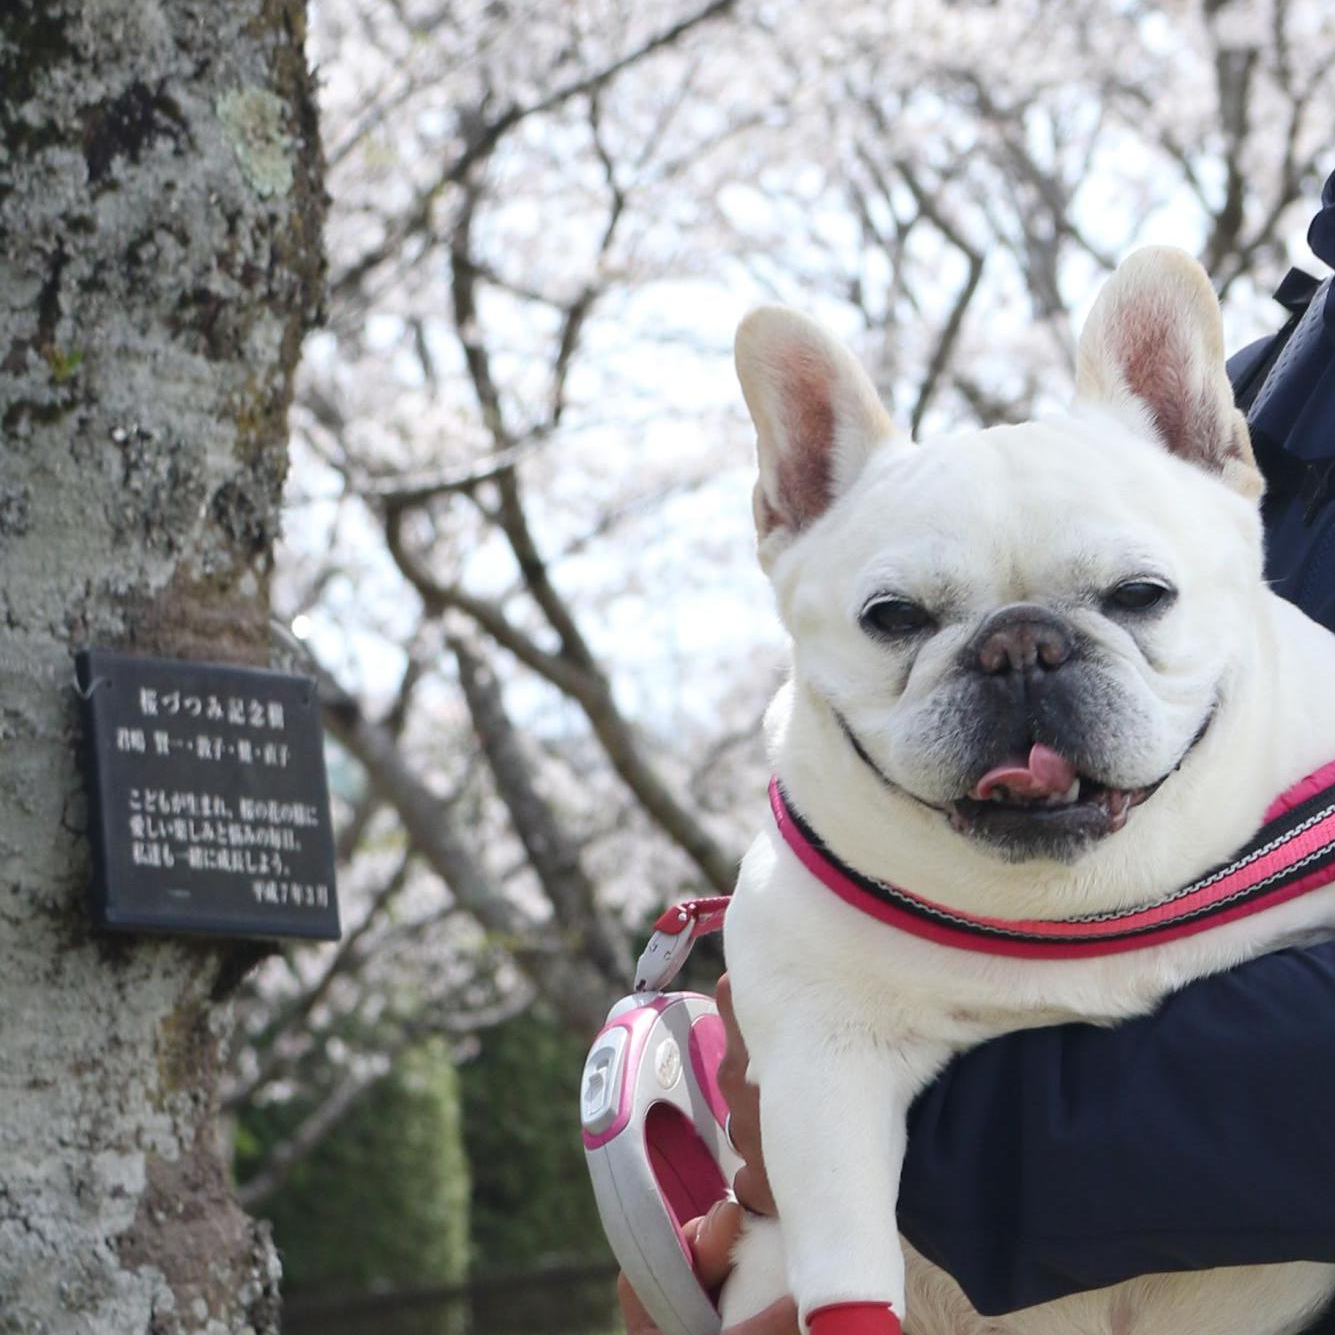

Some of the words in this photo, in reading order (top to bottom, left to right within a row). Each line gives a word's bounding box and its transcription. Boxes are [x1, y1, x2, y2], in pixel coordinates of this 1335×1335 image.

[140, 687, 285, 729] 桜づつみ記念樹
